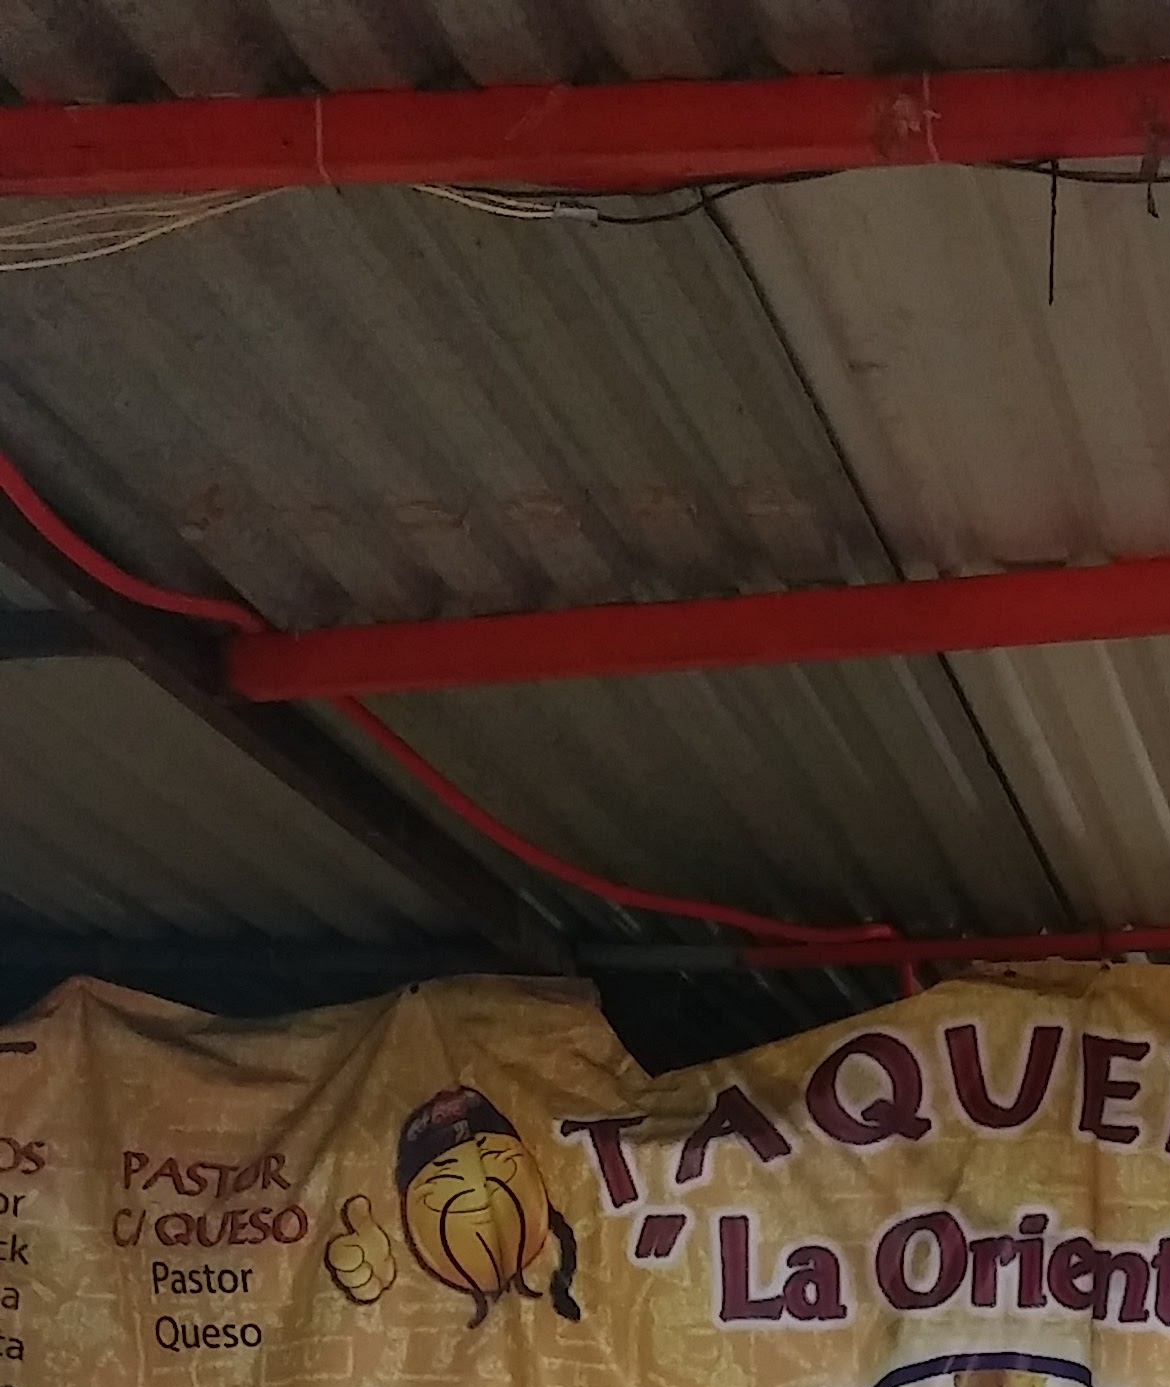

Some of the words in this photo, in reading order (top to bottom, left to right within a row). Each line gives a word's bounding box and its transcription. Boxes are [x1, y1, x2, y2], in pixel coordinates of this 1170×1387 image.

[123, 1151, 291, 1199] PASTOR
[153, 1262, 253, 1294] Pastor
[155, 1316, 261, 1352] Queso
